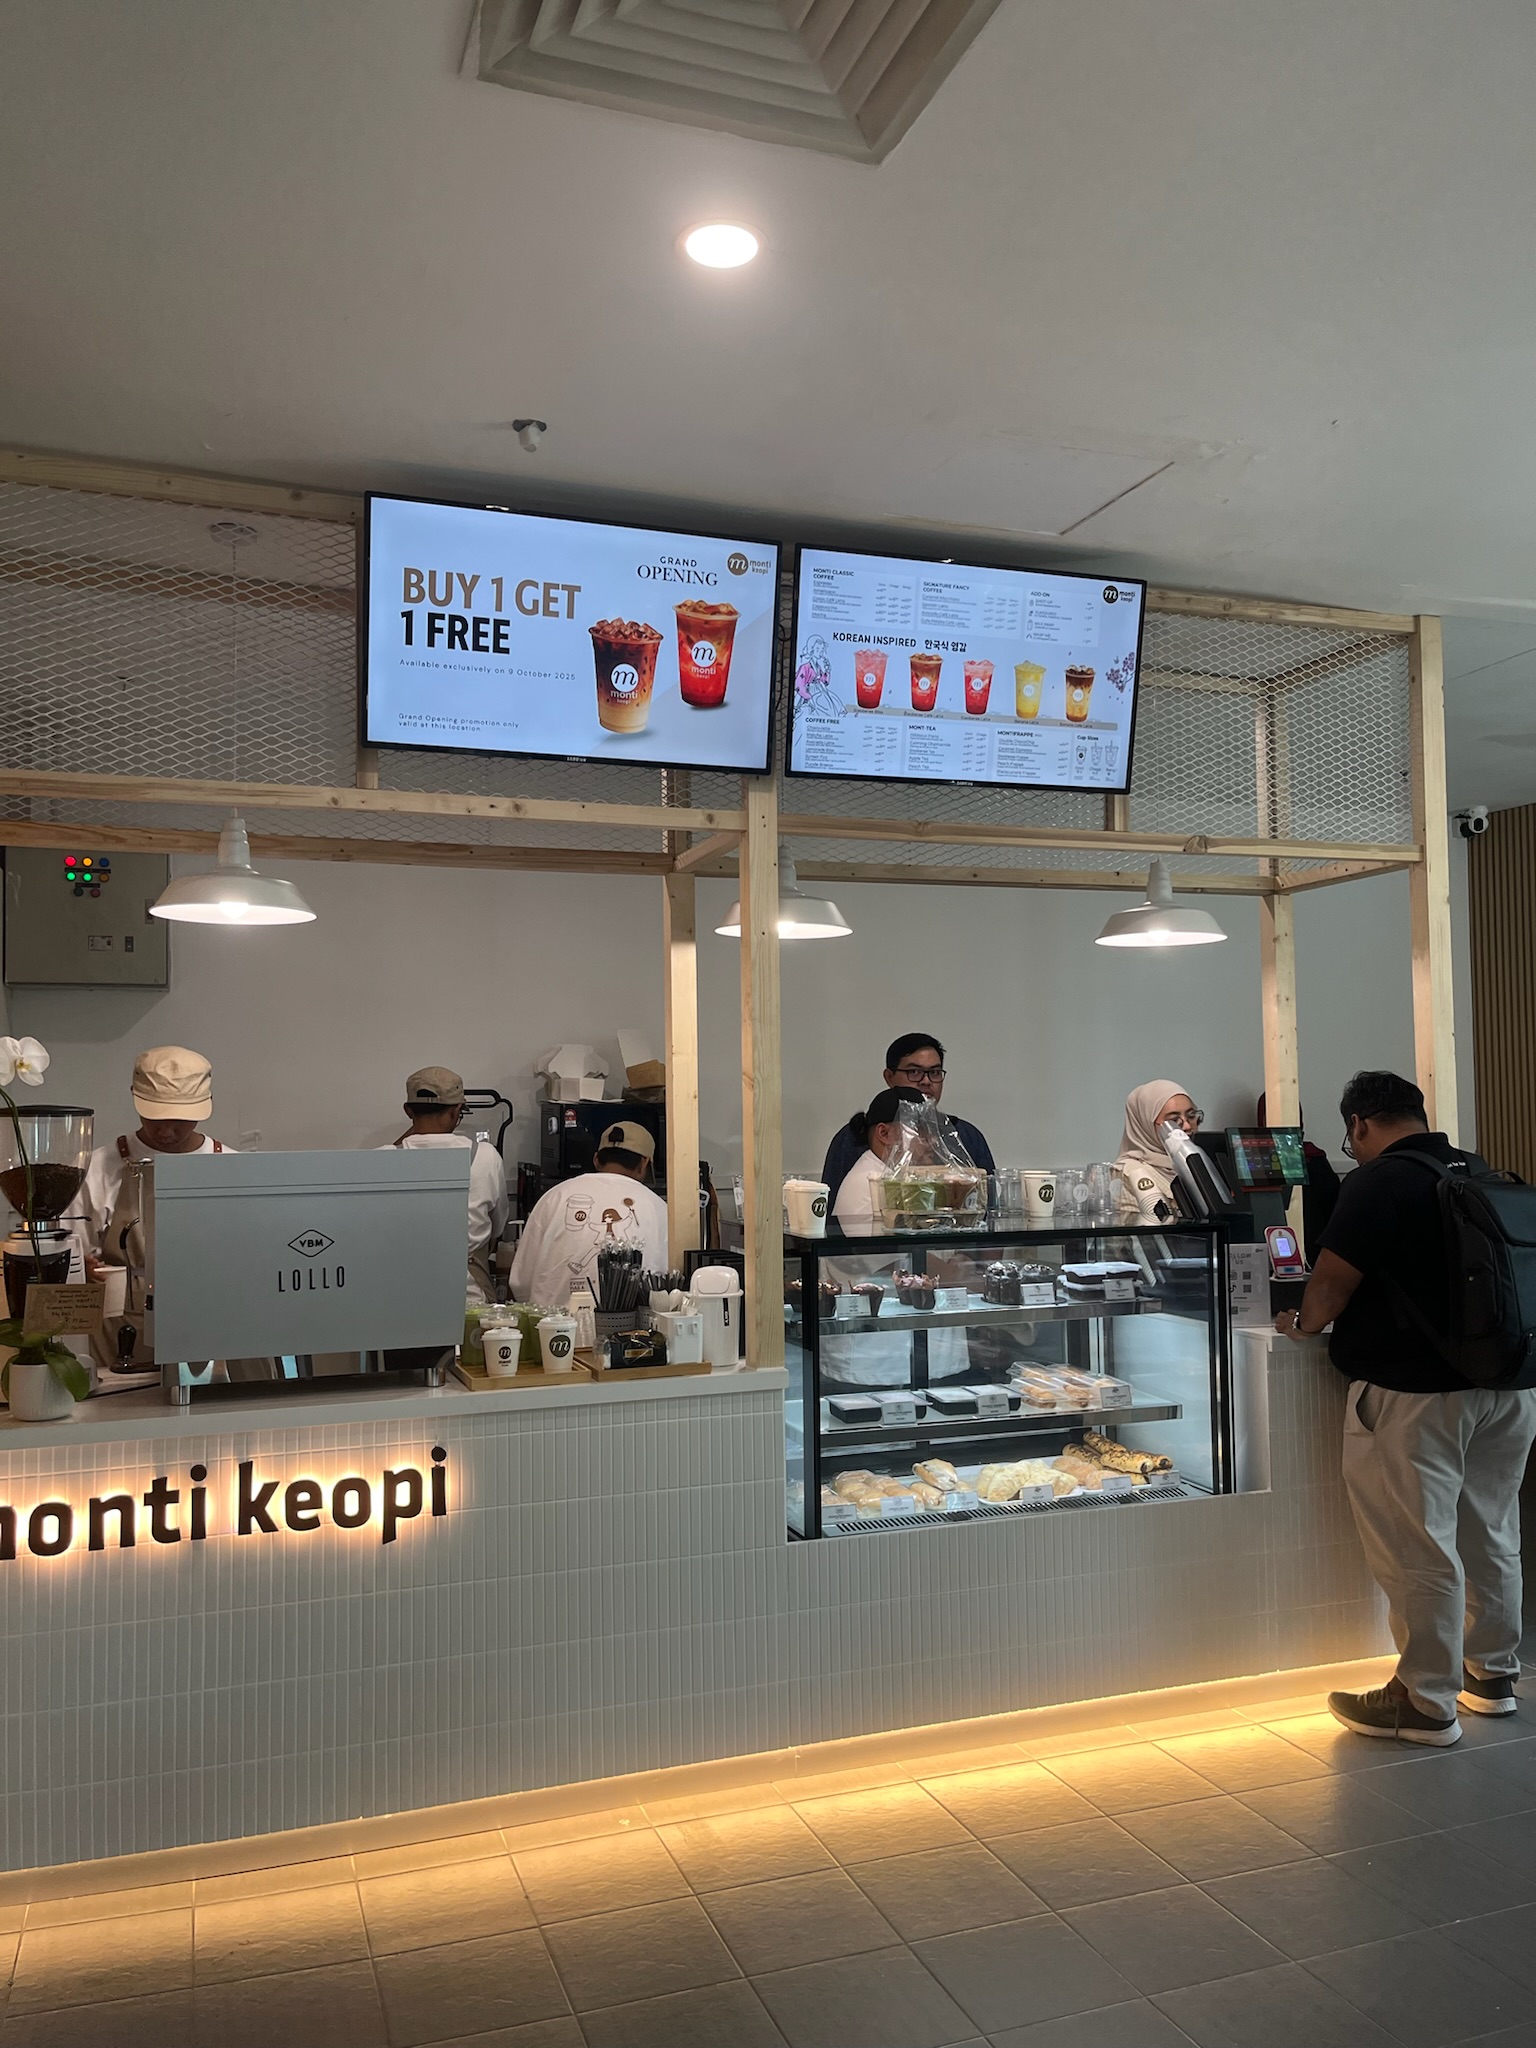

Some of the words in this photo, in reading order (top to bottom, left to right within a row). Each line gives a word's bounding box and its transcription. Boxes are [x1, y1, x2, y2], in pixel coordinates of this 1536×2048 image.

[660, 556, 697, 567] GRAND
[750, 560, 771, 568] monti
[638, 565, 718, 586] OPENING
[404, 567, 481, 609] BUY
[491, 577, 503, 612] 1
[515, 580, 581, 619] GET
[400, 610, 413, 646] 1
[427, 612, 510, 654] FREE
[833, 632, 871, 644] KOREAN
[873, 636, 916, 647] INSPIRED
[925, 639, 949, 651] 한국식
[400, 659, 439, 668] Available
[443, 663, 491, 674] exclusively
[517, 669, 551, 678] October
[692, 666, 716, 674] monti
[611, 690, 638, 699] monti
[426, 715, 457, 724] Opening
[461, 718, 500, 726] promotion
[299, 1239, 323, 1247] VBM
[279, 1266, 344, 1292] LOLLO
[238, 1446, 446, 1545] keopi
